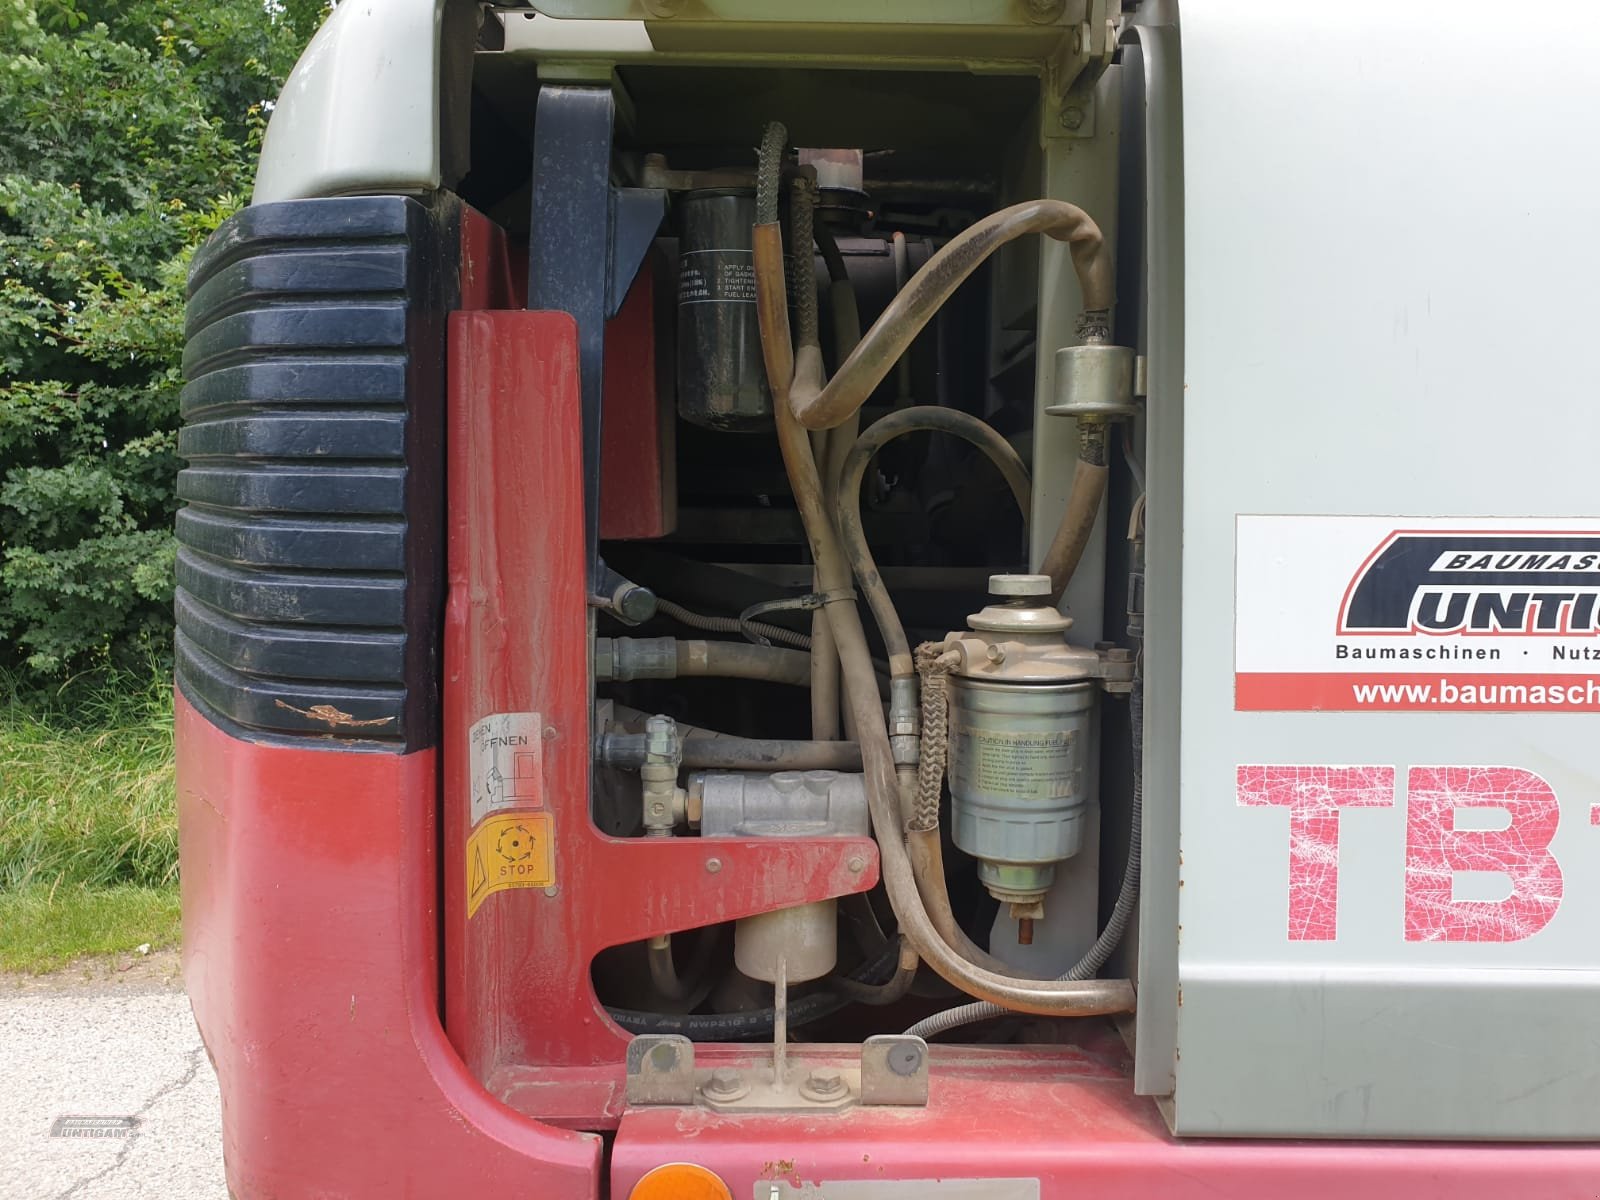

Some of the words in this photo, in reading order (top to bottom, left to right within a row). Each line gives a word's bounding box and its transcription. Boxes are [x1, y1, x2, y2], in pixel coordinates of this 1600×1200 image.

[1444, 554, 1600, 570] BAUMAS
[1416, 592, 1600, 630] UNTI
[1335, 644, 1502, 660] Baumaschinen
[1352, 678, 1600, 705] www.baumasch
[500, 864, 535, 876] STOP
